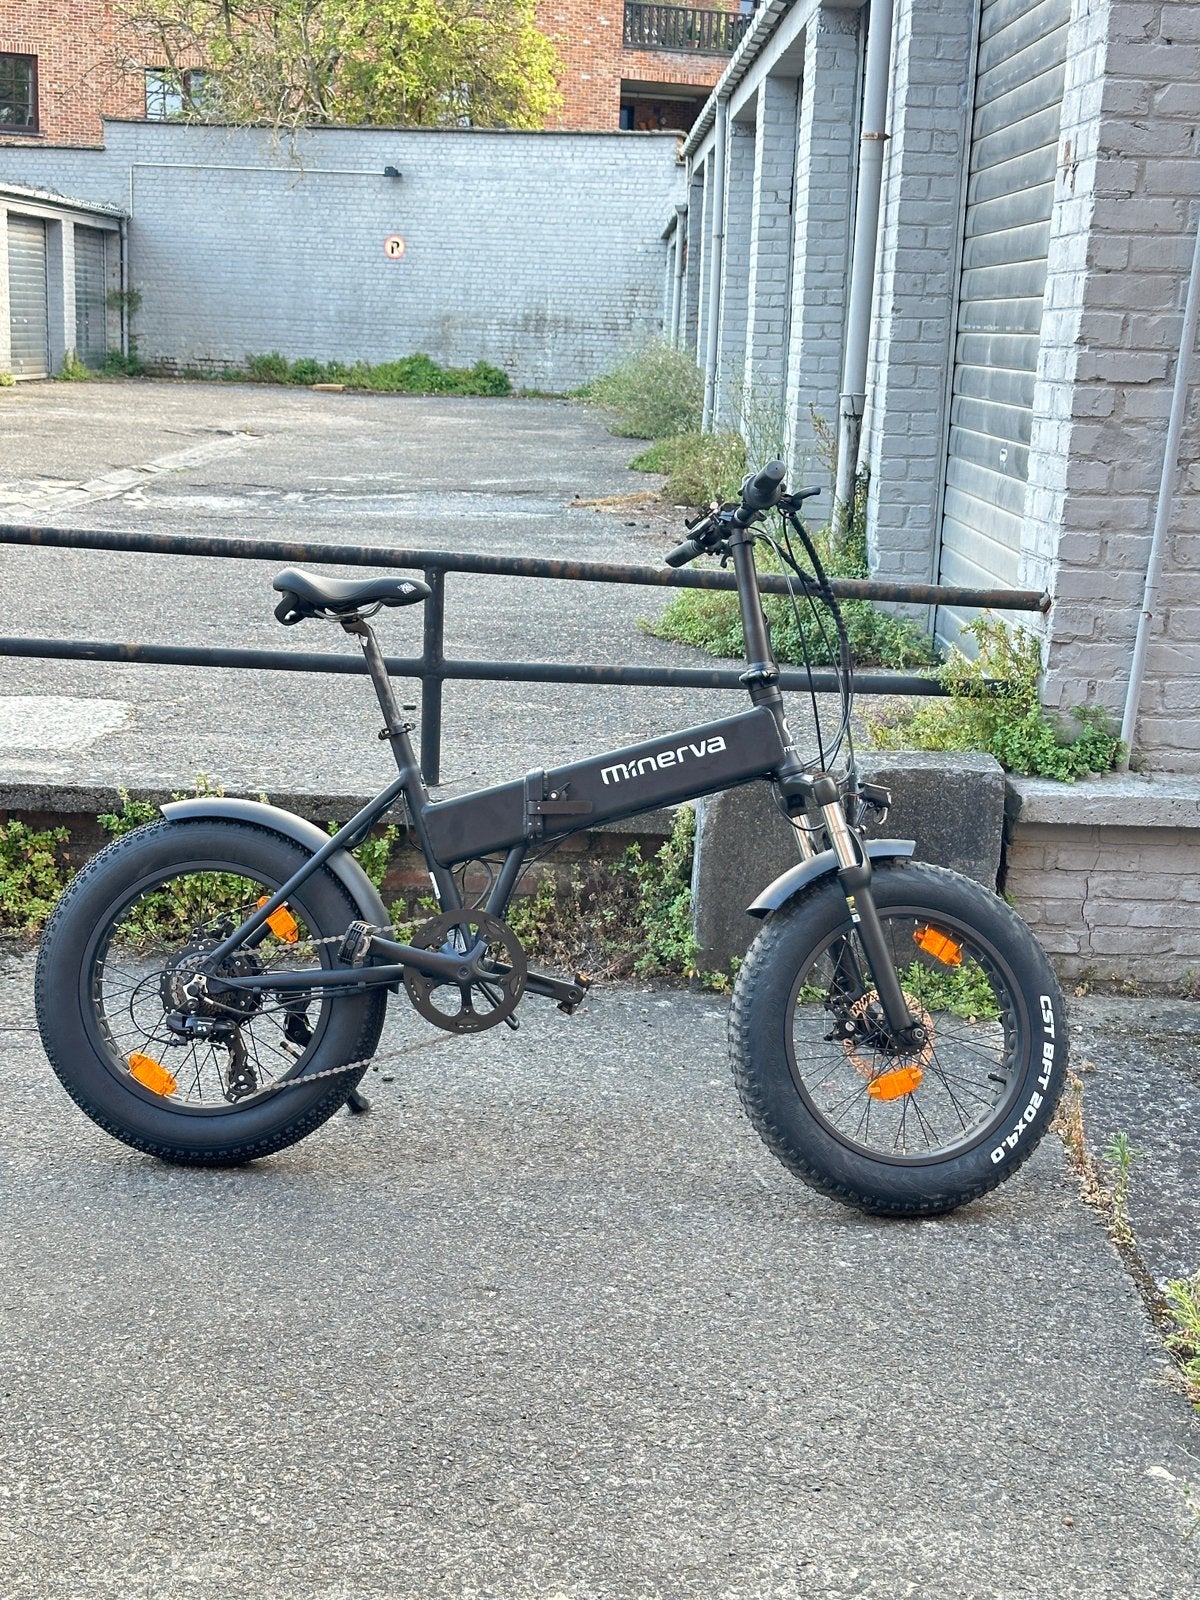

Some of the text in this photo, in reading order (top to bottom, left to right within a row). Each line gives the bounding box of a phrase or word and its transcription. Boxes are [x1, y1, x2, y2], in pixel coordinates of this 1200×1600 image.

[601, 735, 727, 785] minerva
[1039, 995, 1056, 1039] CST
[1037, 1042, 1055, 1091] BFT
